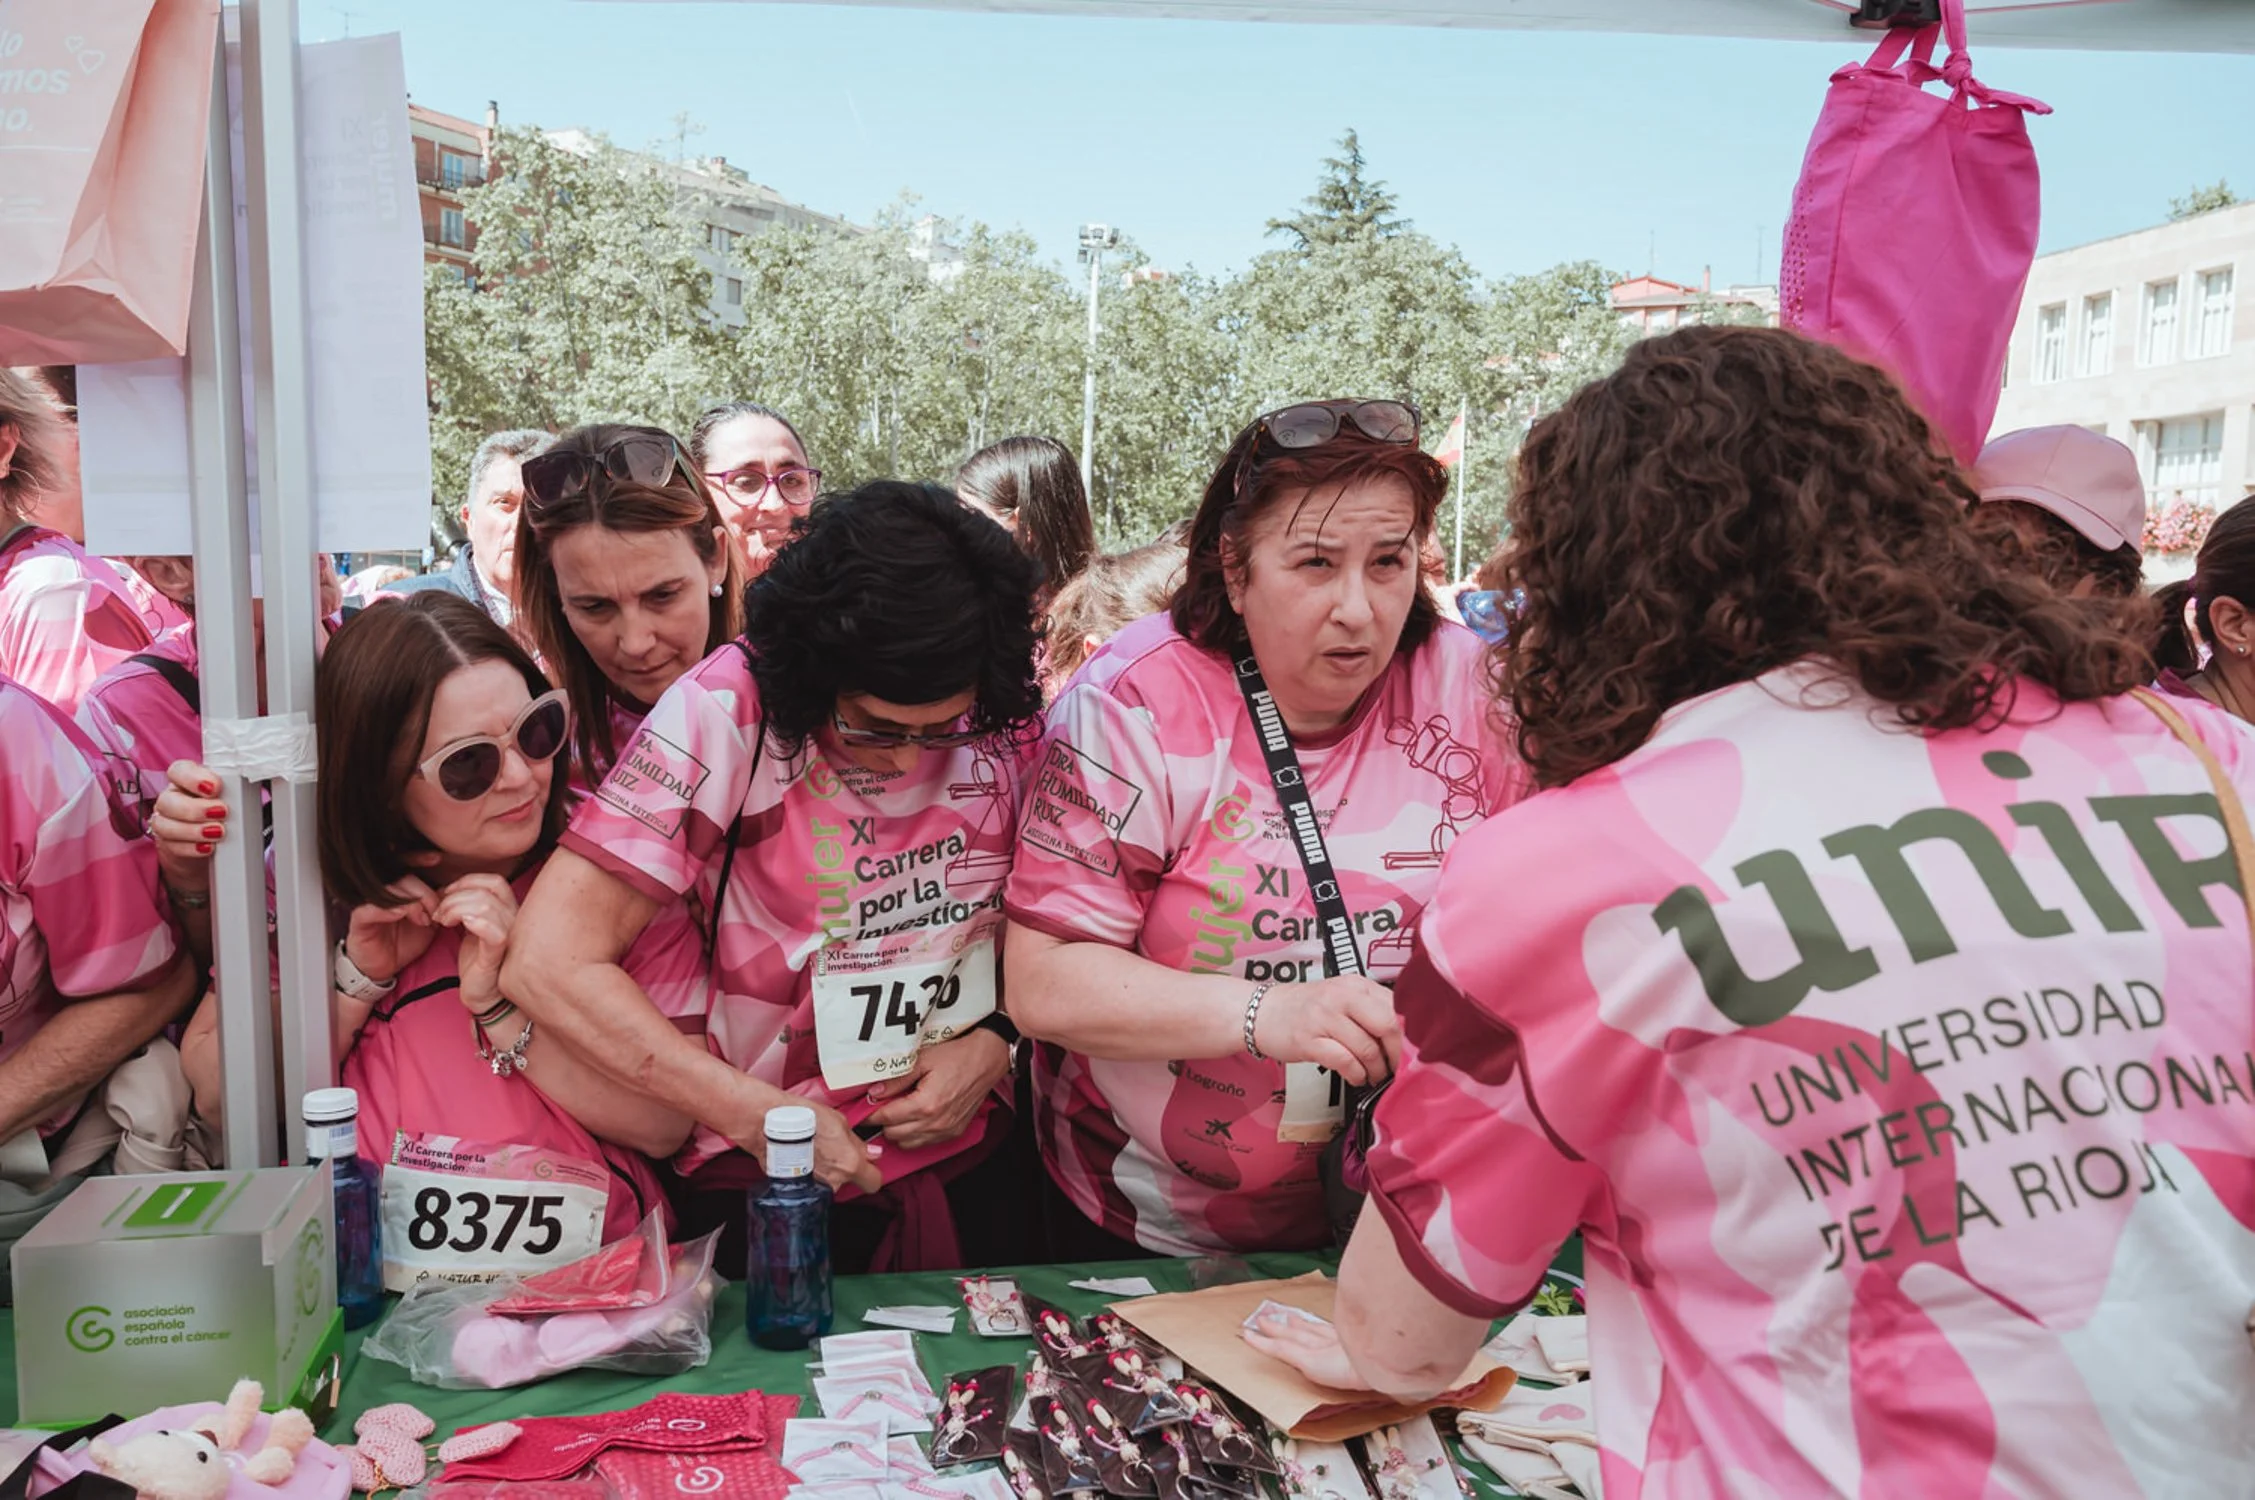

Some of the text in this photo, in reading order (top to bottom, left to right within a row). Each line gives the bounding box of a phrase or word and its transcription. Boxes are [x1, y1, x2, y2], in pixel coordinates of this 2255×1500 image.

[1252, 691, 1289, 752] PUMA
[1050, 746, 1074, 775] DRA
[626, 754, 694, 801] UMILDAD
[1034, 797, 1068, 827] RUIZ
[1040, 770, 1121, 831] HUMILDAD
[849, 817, 876, 846] XI
[1289, 801, 1326, 865] PUMA
[854, 834, 966, 883] Carrera
[1254, 864, 1290, 897] XI
[859, 877, 942, 927] por la
[1189, 857, 1253, 974] ujer
[1251, 908, 1398, 942] Carra
[827, 950, 840, 961] XI
[881, 948, 898, 958] por
[1244, 958, 1313, 984] por
[1751, 980, 2166, 1129] UNIVERSIDAD
[1186, 1068, 1246, 1099] Logroño
[401, 1140, 486, 1163] XI Carrera por la
[408, 1187, 564, 1255] 8375
[1903, 1180, 2003, 1249] LA
[124, 1305, 195, 1319] asociación
[124, 1319, 185, 1333] española
[124, 1334, 168, 1346] contra
[171, 1332, 183, 1344] el
